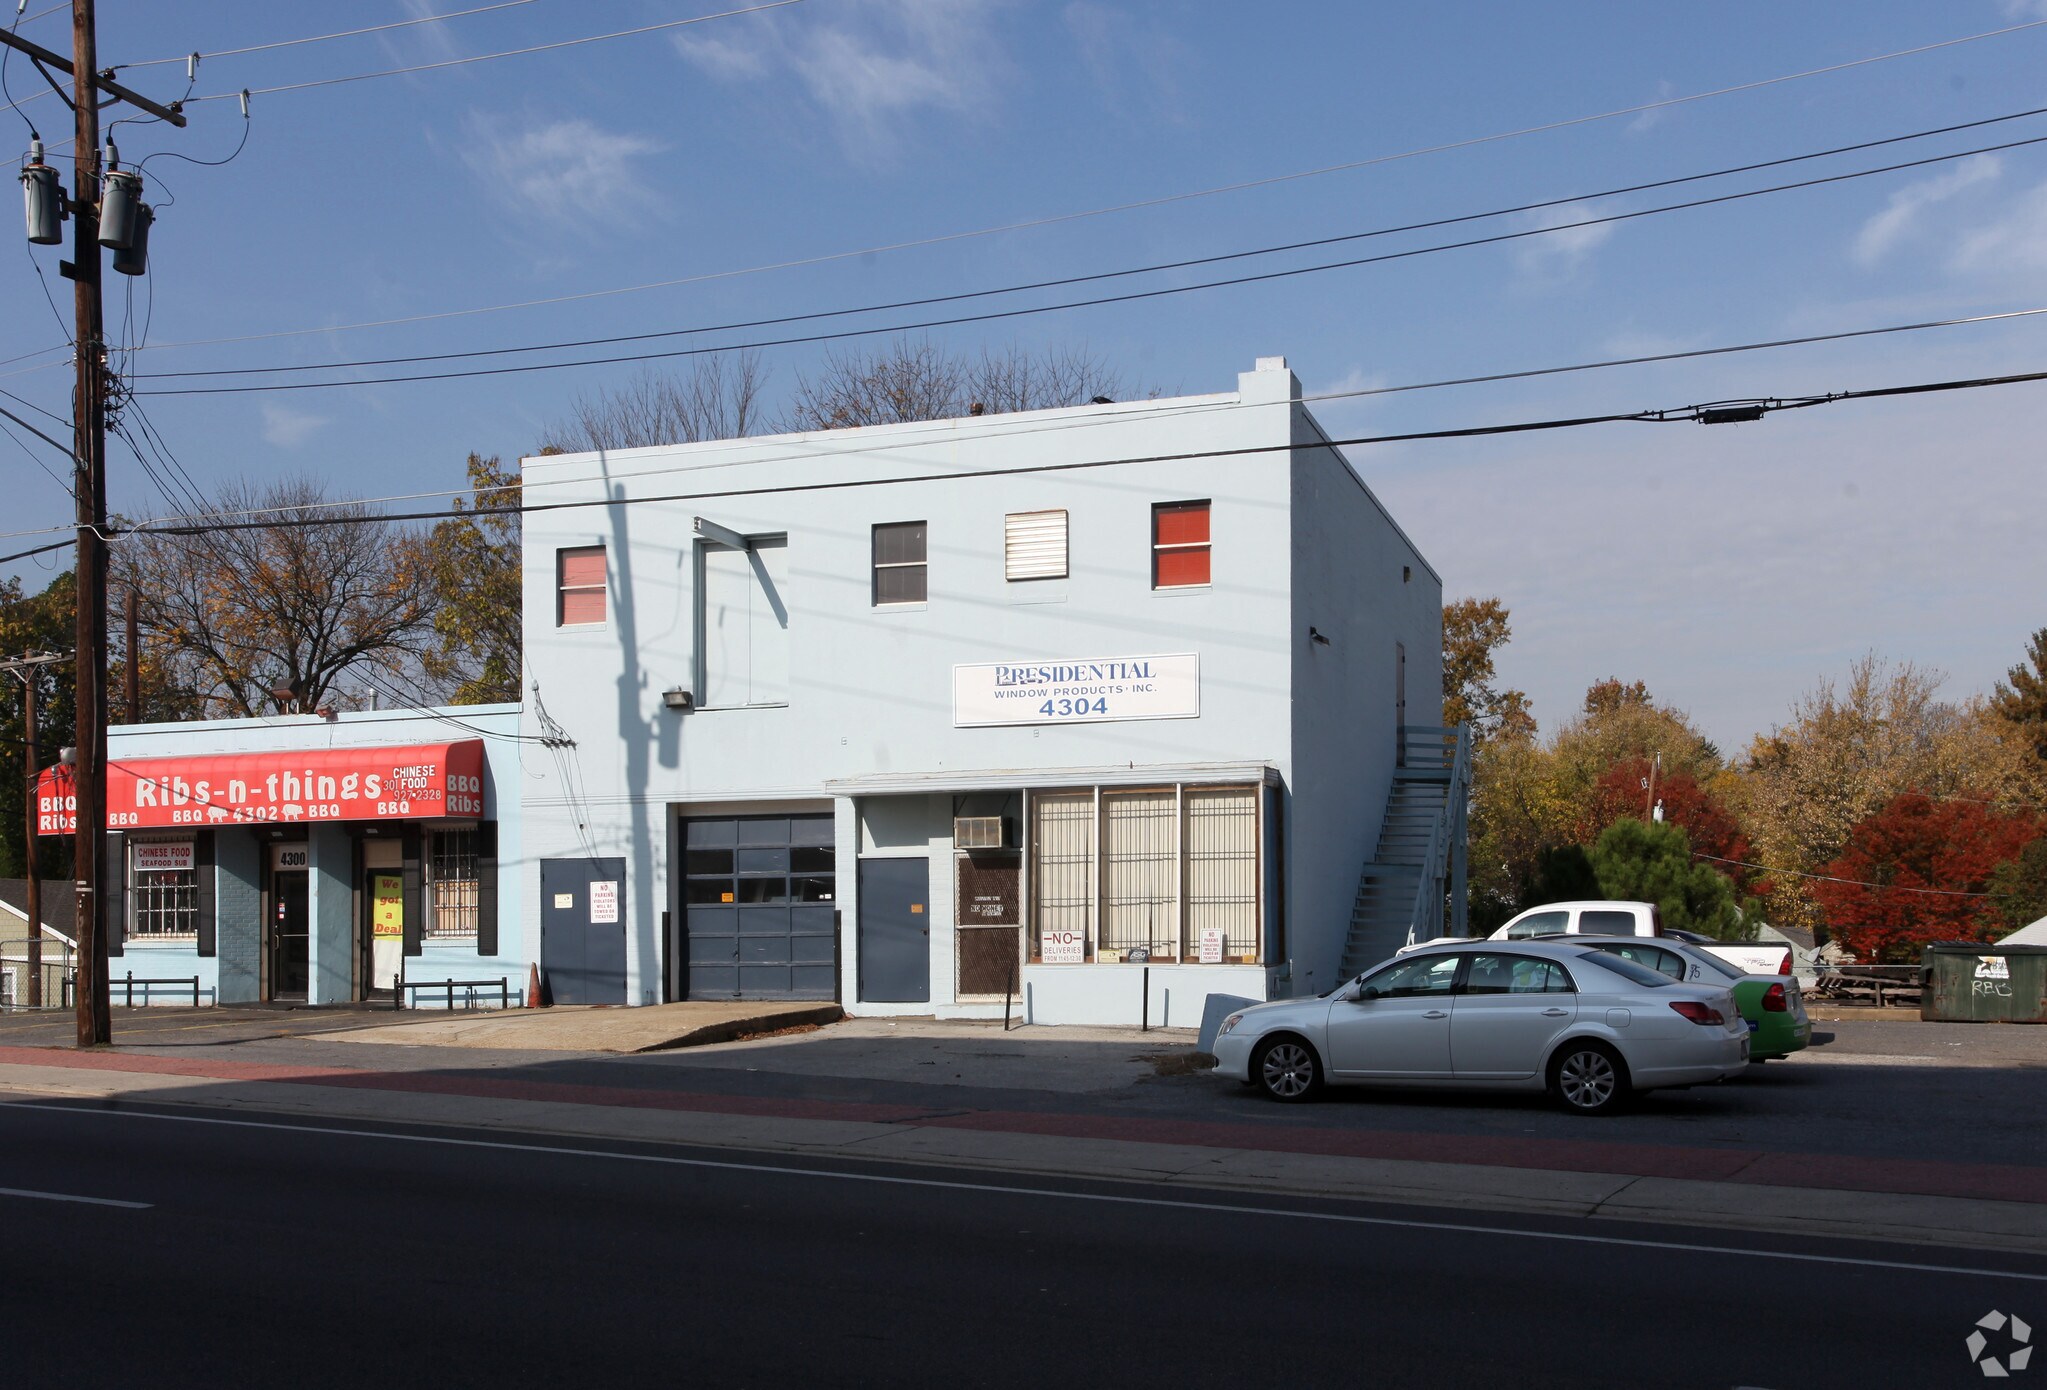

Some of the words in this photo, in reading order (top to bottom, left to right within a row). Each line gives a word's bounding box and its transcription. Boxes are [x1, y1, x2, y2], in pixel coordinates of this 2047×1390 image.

[995, 662, 1157, 686] PRESIDENTIAL
[994, 689, 1048, 699] WINDOW
[1132, 683, 1157, 693] INC.
[1039, 697, 1108, 716] 4304
[393, 765, 436, 779] CHINESE
[135, 769, 381, 808] Ribs-n-things
[383, 779, 399, 791] 301
[401, 777, 427, 790] FOOD
[447, 774, 480, 793] BBQ
[40, 795, 77, 813] BBQ
[377, 801, 410, 815] BBQ
[447, 794, 481, 813] Ribs
[109, 812, 139, 826] BBQ
[173, 809, 203, 823] BBQ
[232, 805, 278, 822] 4302
[308, 803, 340, 818] BBQ
[40, 814, 77, 831] Ribs
[138, 847, 168, 858] CHINESE
[171, 847, 190, 857] FOOD
[281, 852, 306, 866] 4300
[141, 859, 172, 867] SEAFOOD
[174, 859, 187, 867] SUB
[381, 879, 399, 889] We
[379, 895, 400, 906] got
[386, 911, 393, 919] a
[374, 924, 402, 934] Deal
[1044, 946, 1081, 955] DELIVERIES
